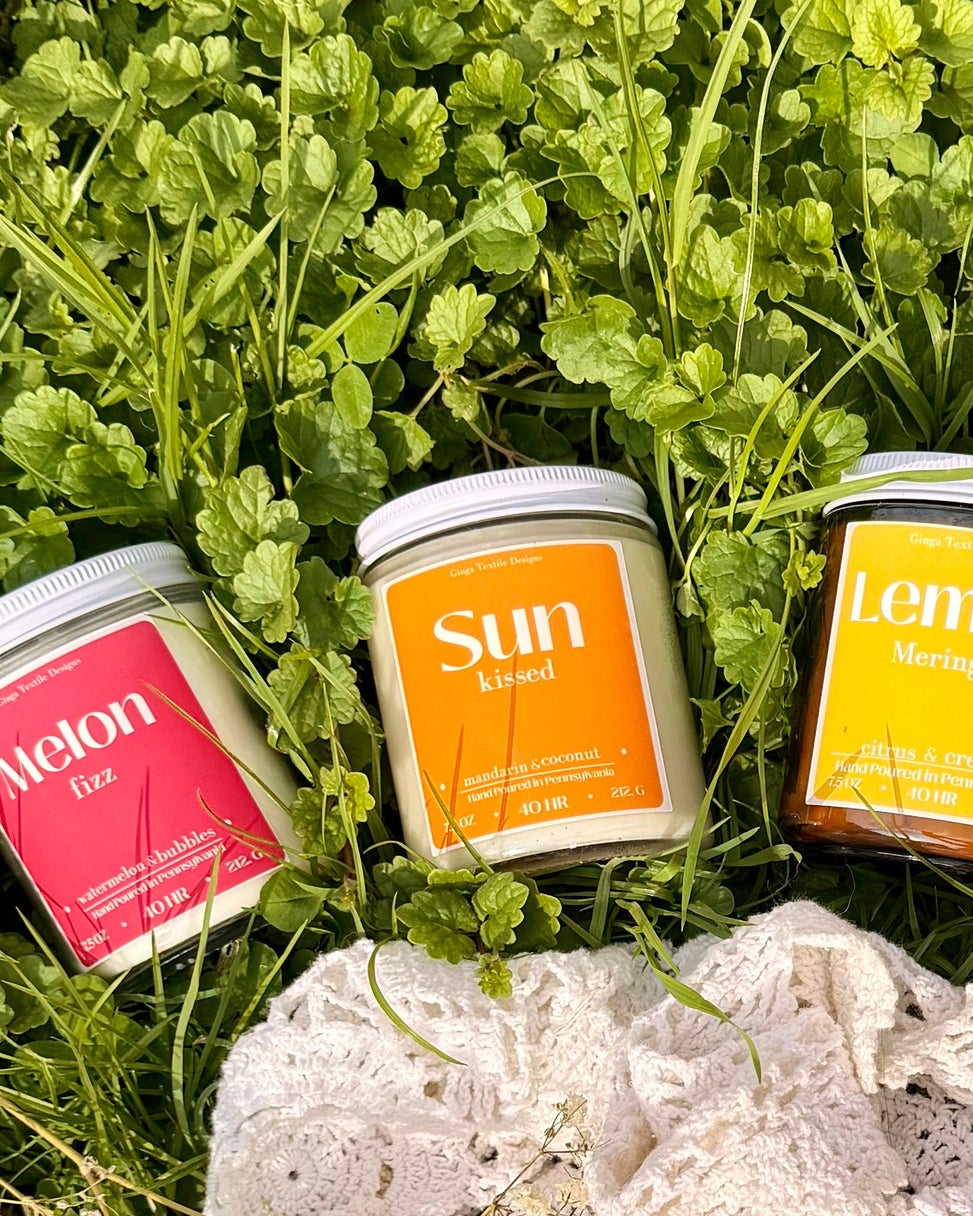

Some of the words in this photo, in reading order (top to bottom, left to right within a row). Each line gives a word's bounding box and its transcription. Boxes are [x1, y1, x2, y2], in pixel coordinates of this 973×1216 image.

[909, 532, 942, 548] Ginga
[476, 559, 507, 571] Textile
[509, 555, 543, 566] Designs
[433, 600, 585, 672] Sun
[17, 674, 48, 693] Textile
[48, 659, 81, 677] Designs
[476, 658, 557, 693] kissed
[0, 692, 157, 800] Melon
[860, 738, 916, 761] citrus
[924, 747, 938, 762] &
[69, 767, 118, 800] fizz
[463, 761, 529, 787] mandarin
[541, 747, 601, 767] coconut
[834, 760, 869, 775] Hand
[869, 763, 922, 781] Poured
[467, 787, 494, 803] Hand
[493, 780, 531, 797] Poured
[544, 766, 616, 786] Pennsylvania
[519, 800, 542, 817] 40
[544, 795, 569, 812] HR
[635, 784, 646, 797] G
[908, 785, 930, 802] 40
[932, 788, 959, 807] HR
[77, 861, 147, 905] watermelon
[154, 828, 217, 863] bubbles
[91, 901, 116, 920] Hand
[112, 882, 148, 907] Poured
[143, 900, 166, 920] 40
[164, 886, 192, 908] HR
